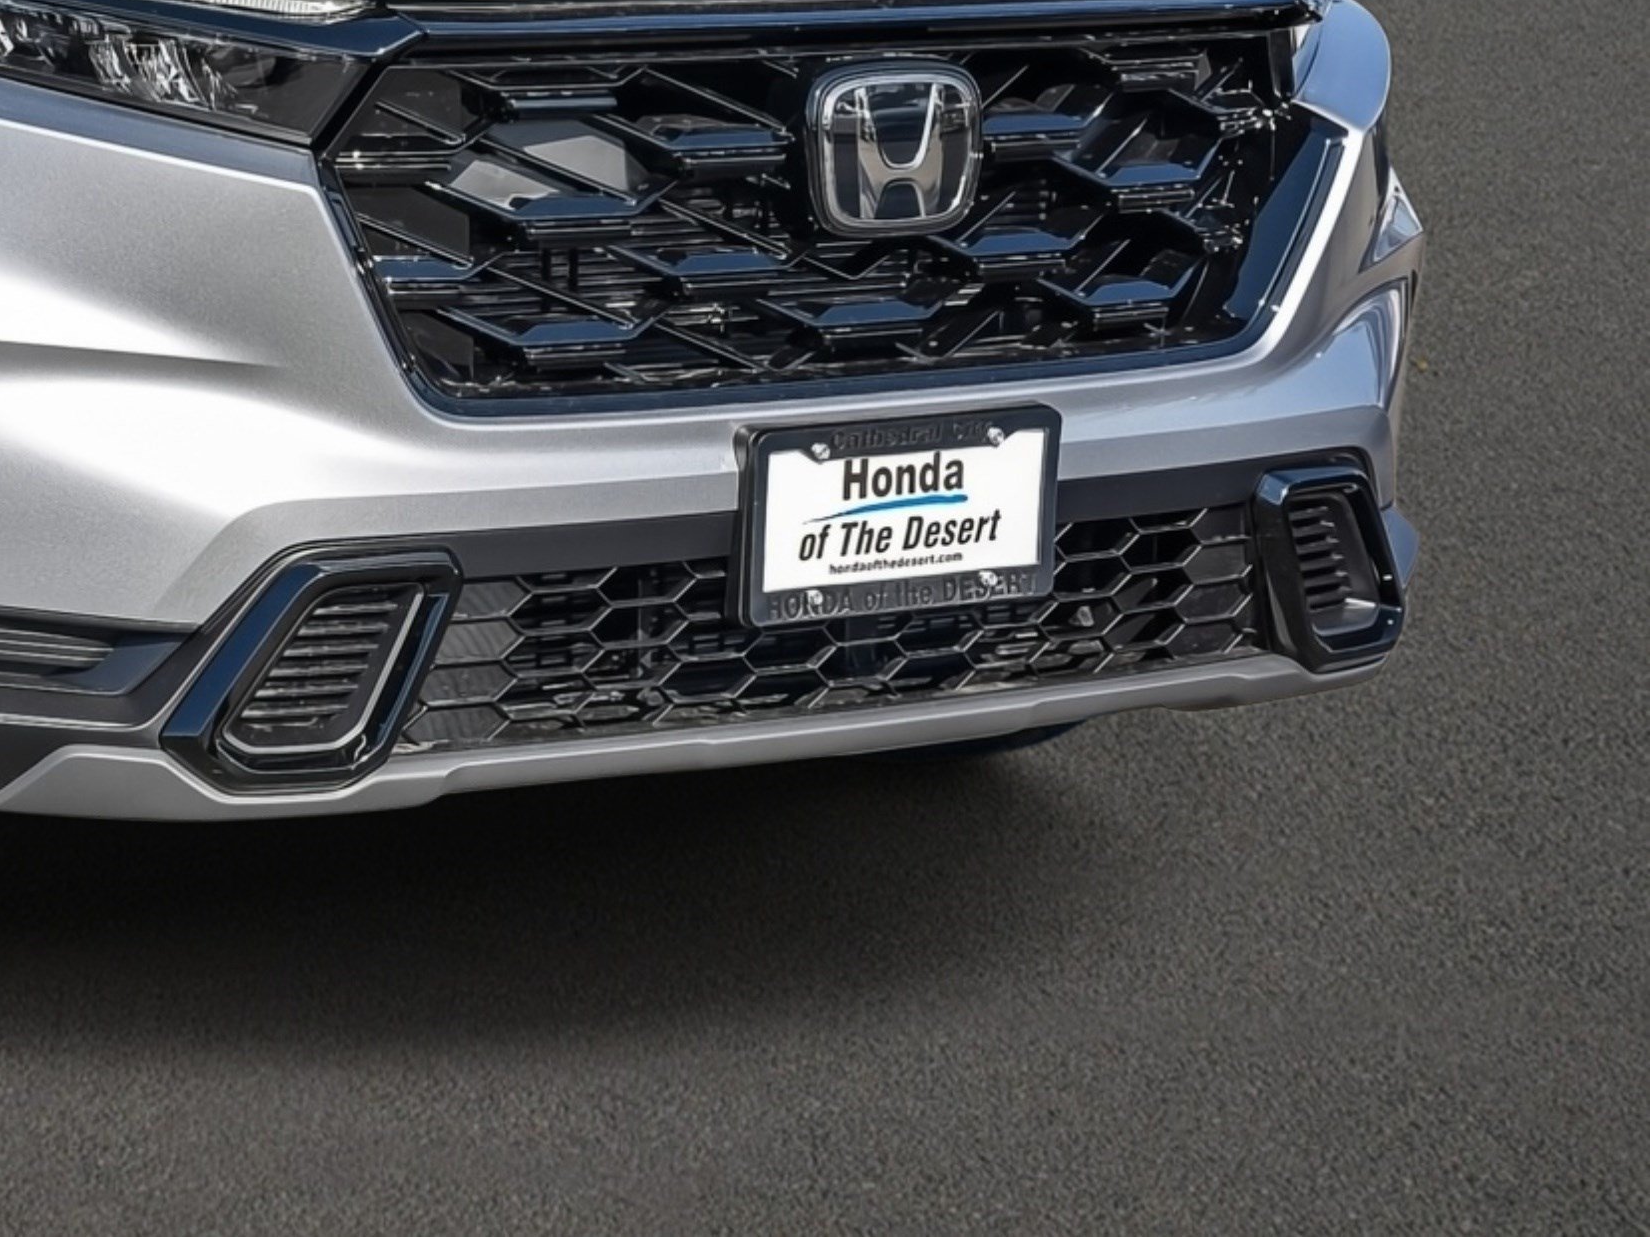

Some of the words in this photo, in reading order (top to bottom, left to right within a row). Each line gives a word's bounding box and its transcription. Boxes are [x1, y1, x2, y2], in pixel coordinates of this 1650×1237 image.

[842, 450, 965, 501] Honda
[799, 524, 831, 561] of
[840, 519, 893, 558] The
[902, 509, 1002, 551] Desert
[828, 550, 963, 575] hondaofthedesert.com
[864, 590, 888, 612] of
